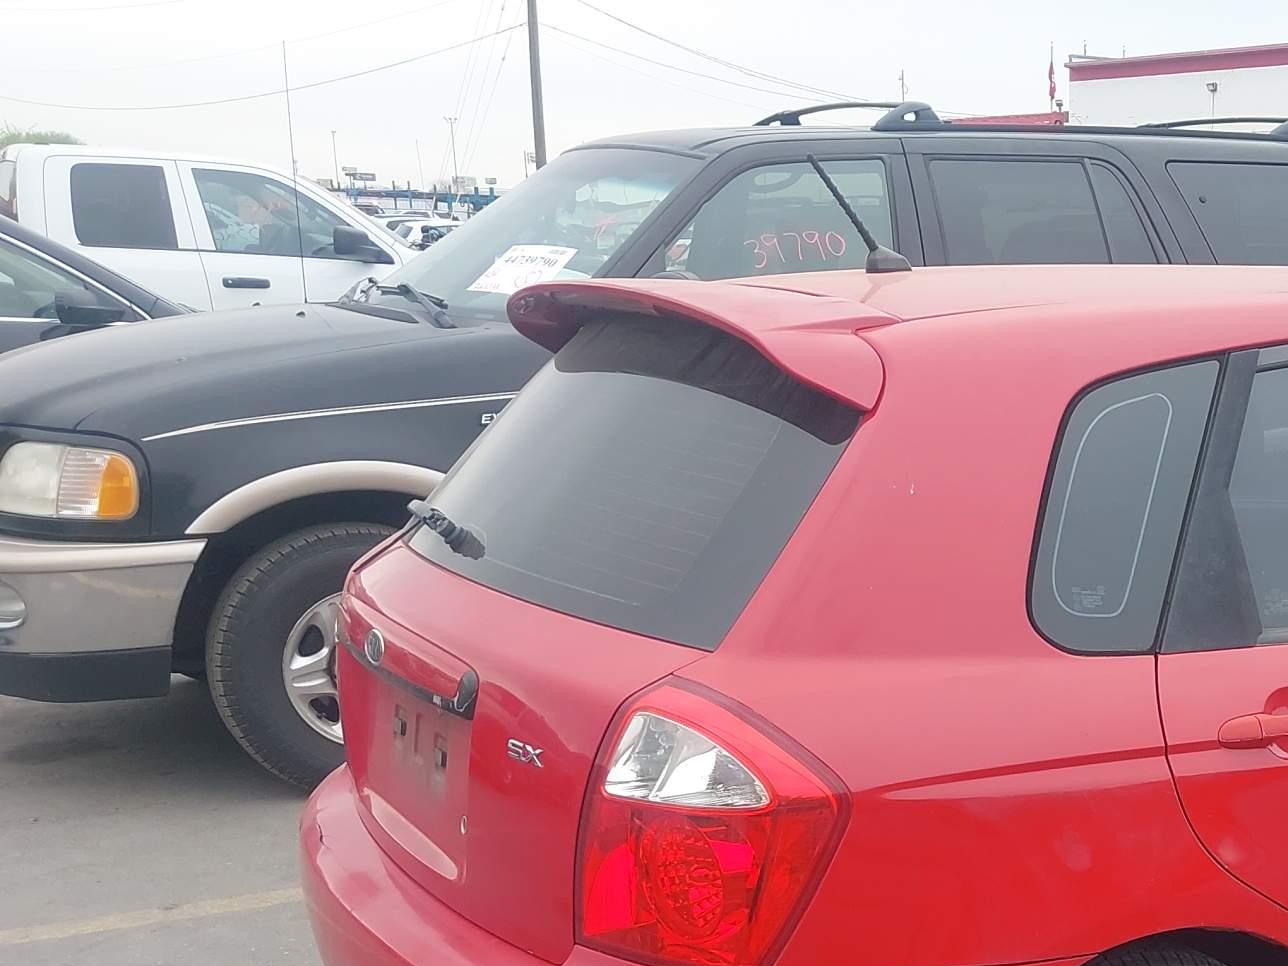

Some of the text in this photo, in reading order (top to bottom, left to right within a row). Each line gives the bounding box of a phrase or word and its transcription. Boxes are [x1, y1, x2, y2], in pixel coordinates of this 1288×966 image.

[503, 255, 559, 268] 44739790
[742, 230, 846, 268] 39790
[507, 737, 545, 768] SX
